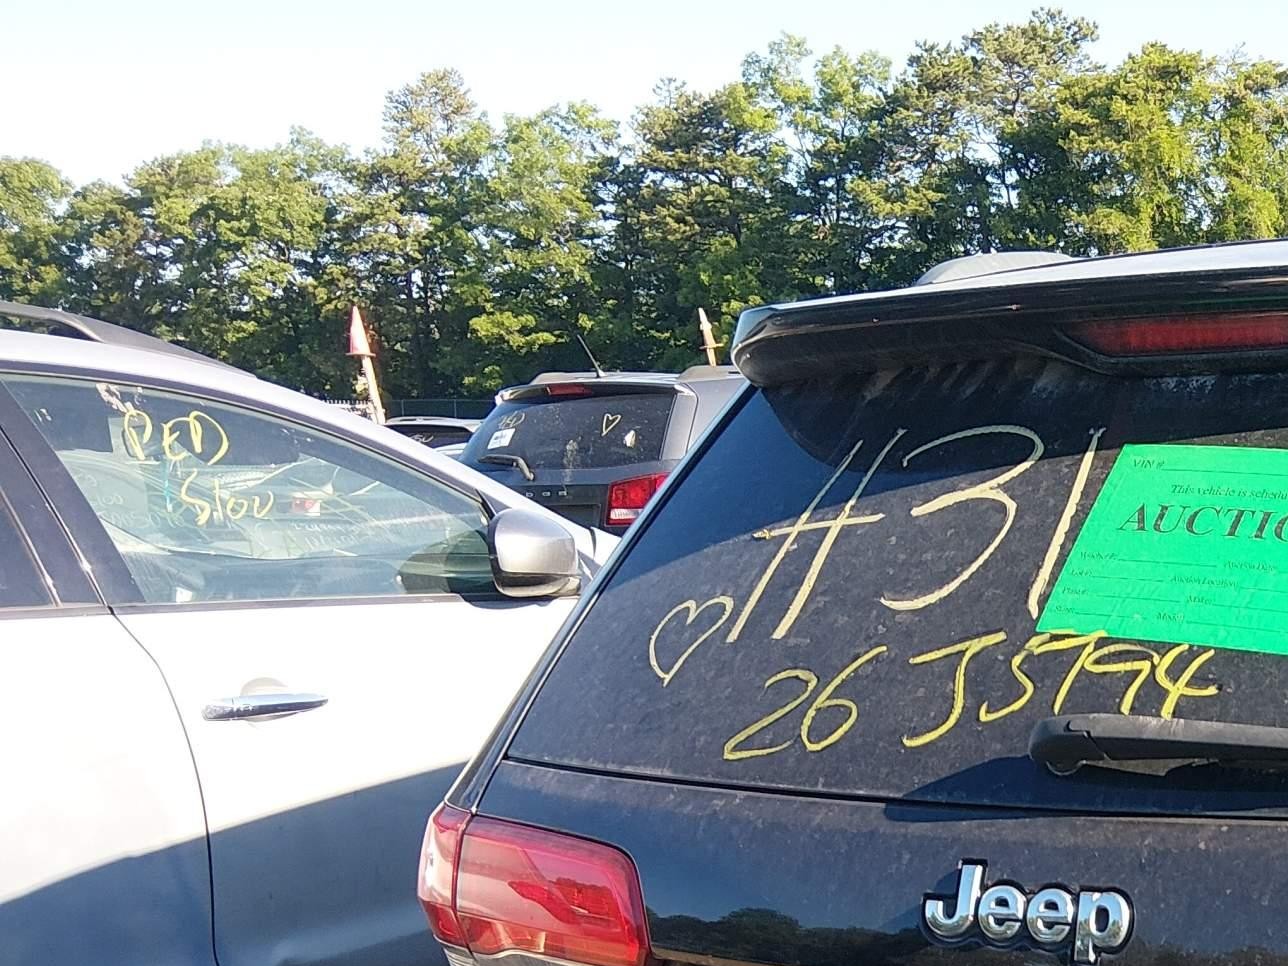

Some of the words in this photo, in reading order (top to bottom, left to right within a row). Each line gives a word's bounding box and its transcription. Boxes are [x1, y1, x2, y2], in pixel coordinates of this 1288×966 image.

[1133, 458, 1155, 469] VIN
[1171, 484, 1195, 494] This
[1198, 485, 1236, 497] vehicle
[1238, 487, 1247, 497] is
